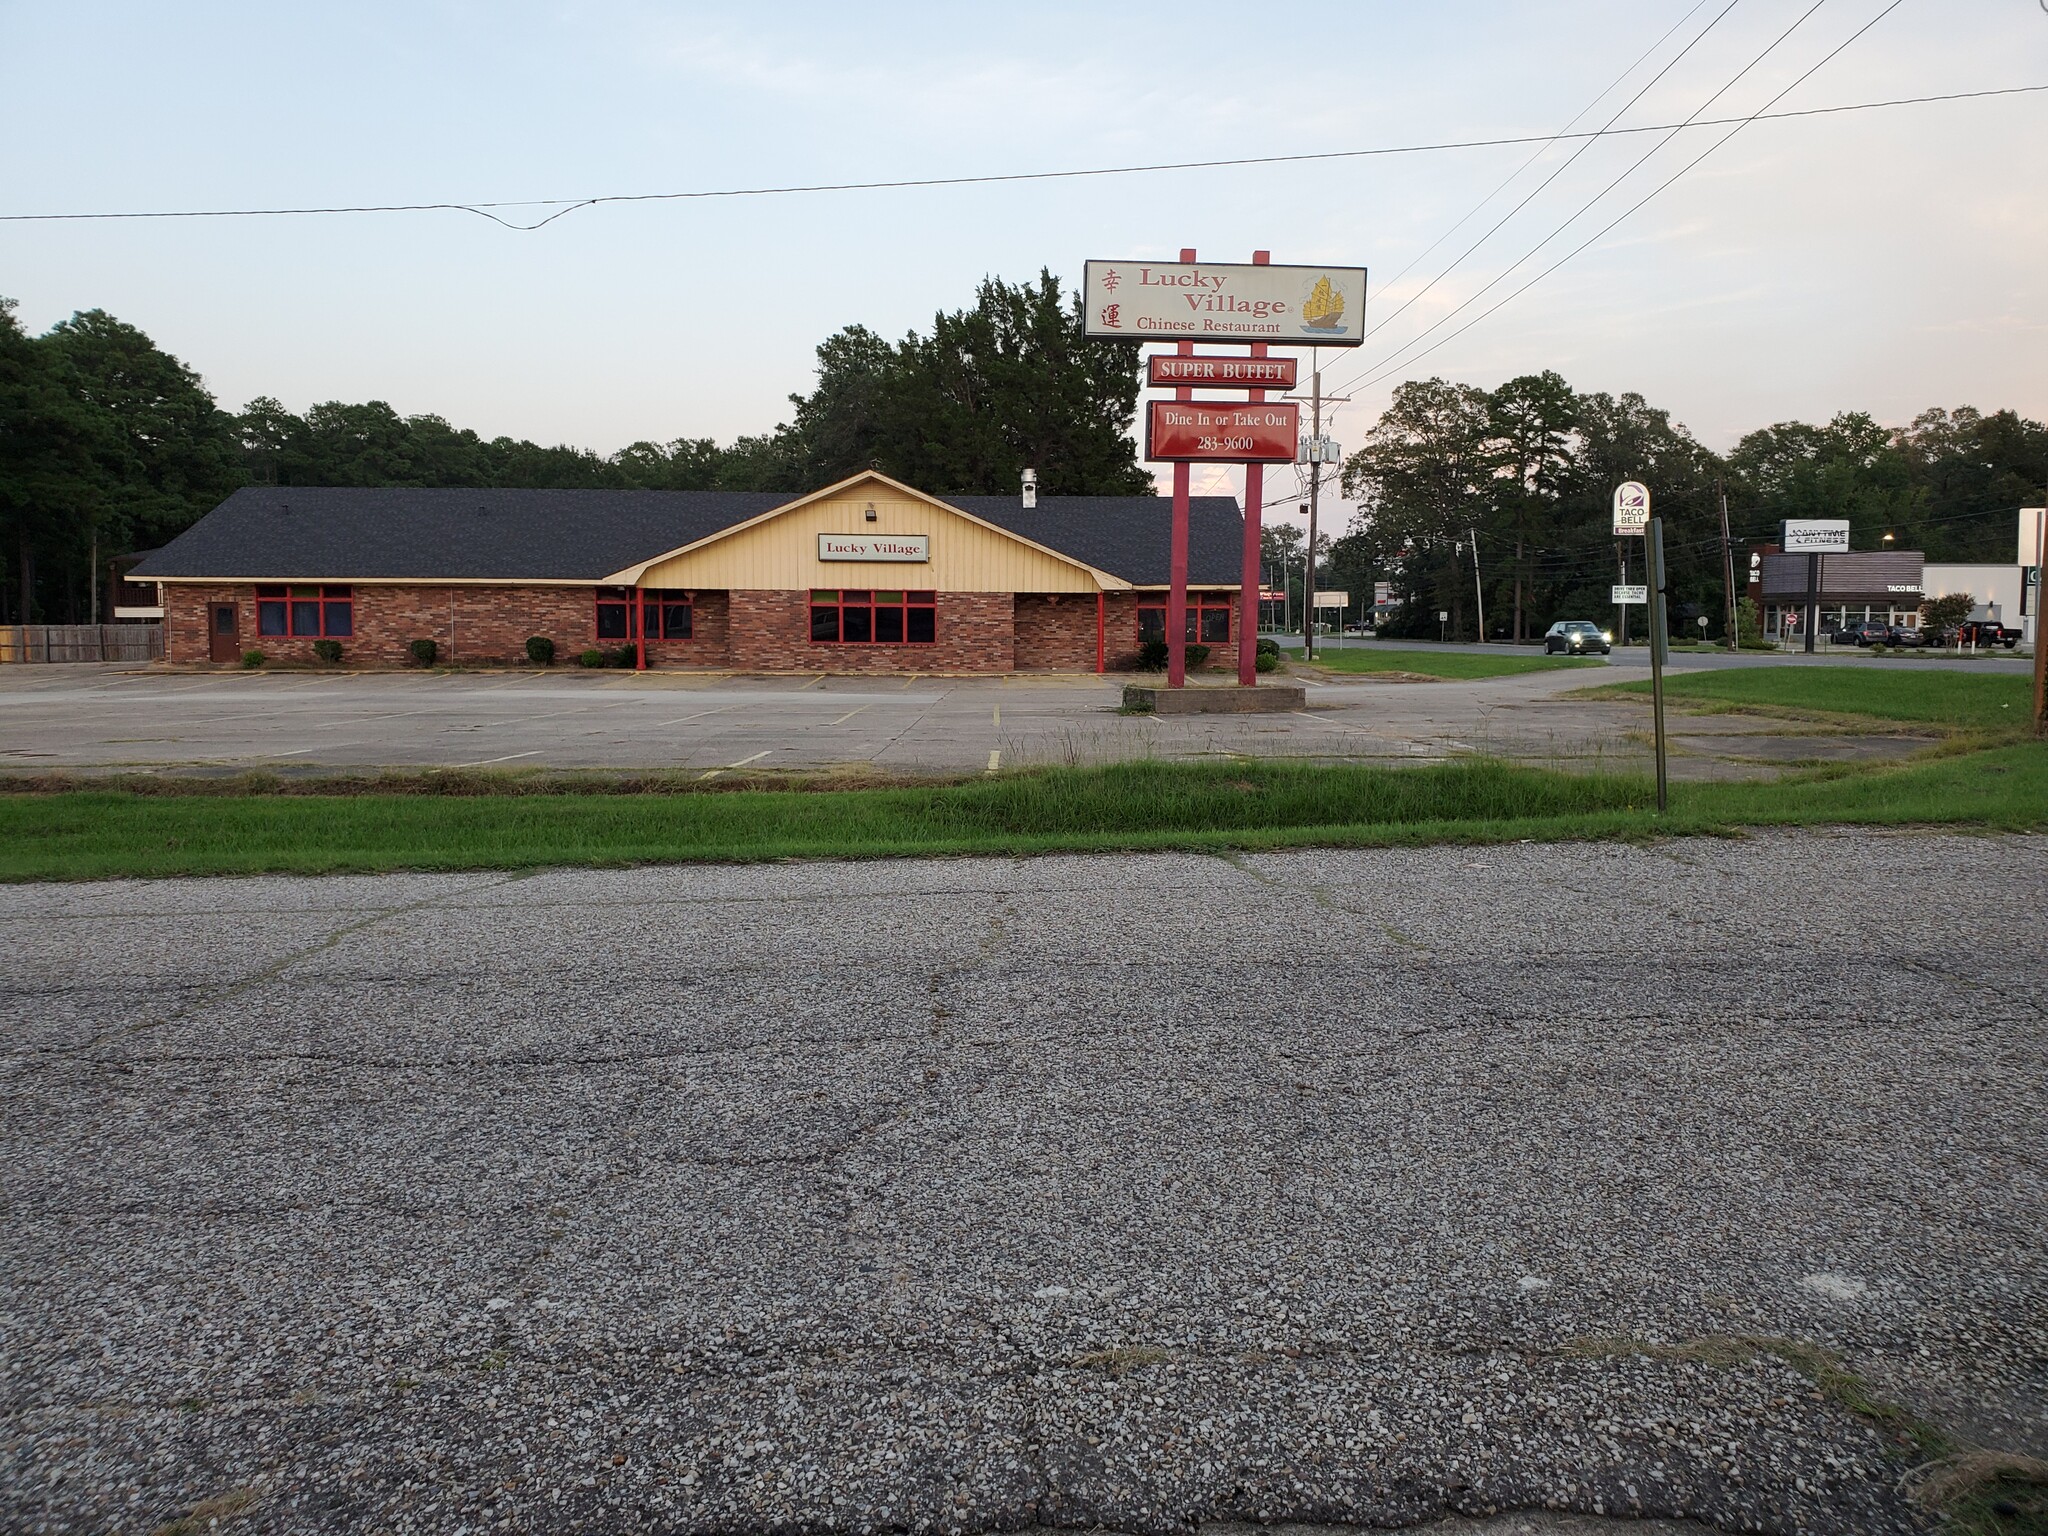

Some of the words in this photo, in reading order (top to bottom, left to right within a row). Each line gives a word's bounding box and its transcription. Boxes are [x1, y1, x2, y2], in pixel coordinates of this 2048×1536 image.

[1139, 268, 1228, 293] Lucky
[1101, 268, 1123, 329] 幸運
[1183, 293, 1287, 319] Village
[1136, 316, 1196, 332] Chinese
[1202, 318, 1281, 334] Restaurant
[1160, 361, 1215, 379] SUPER
[1222, 362, 1286, 380] BUFFET
[1165, 412, 1193, 426] Dine
[1197, 412, 1211, 426] In
[1215, 415, 1229, 426] or
[1232, 412, 1261, 427] Take
[1265, 413, 1287, 427] Out
[1197, 436, 1254, 451] 283-9600
[1619, 508, 1645, 516] TACO
[1621, 516, 1644, 524] BELL
[826, 542, 867, 556] Lucky
[872, 543, 921, 556] Village
